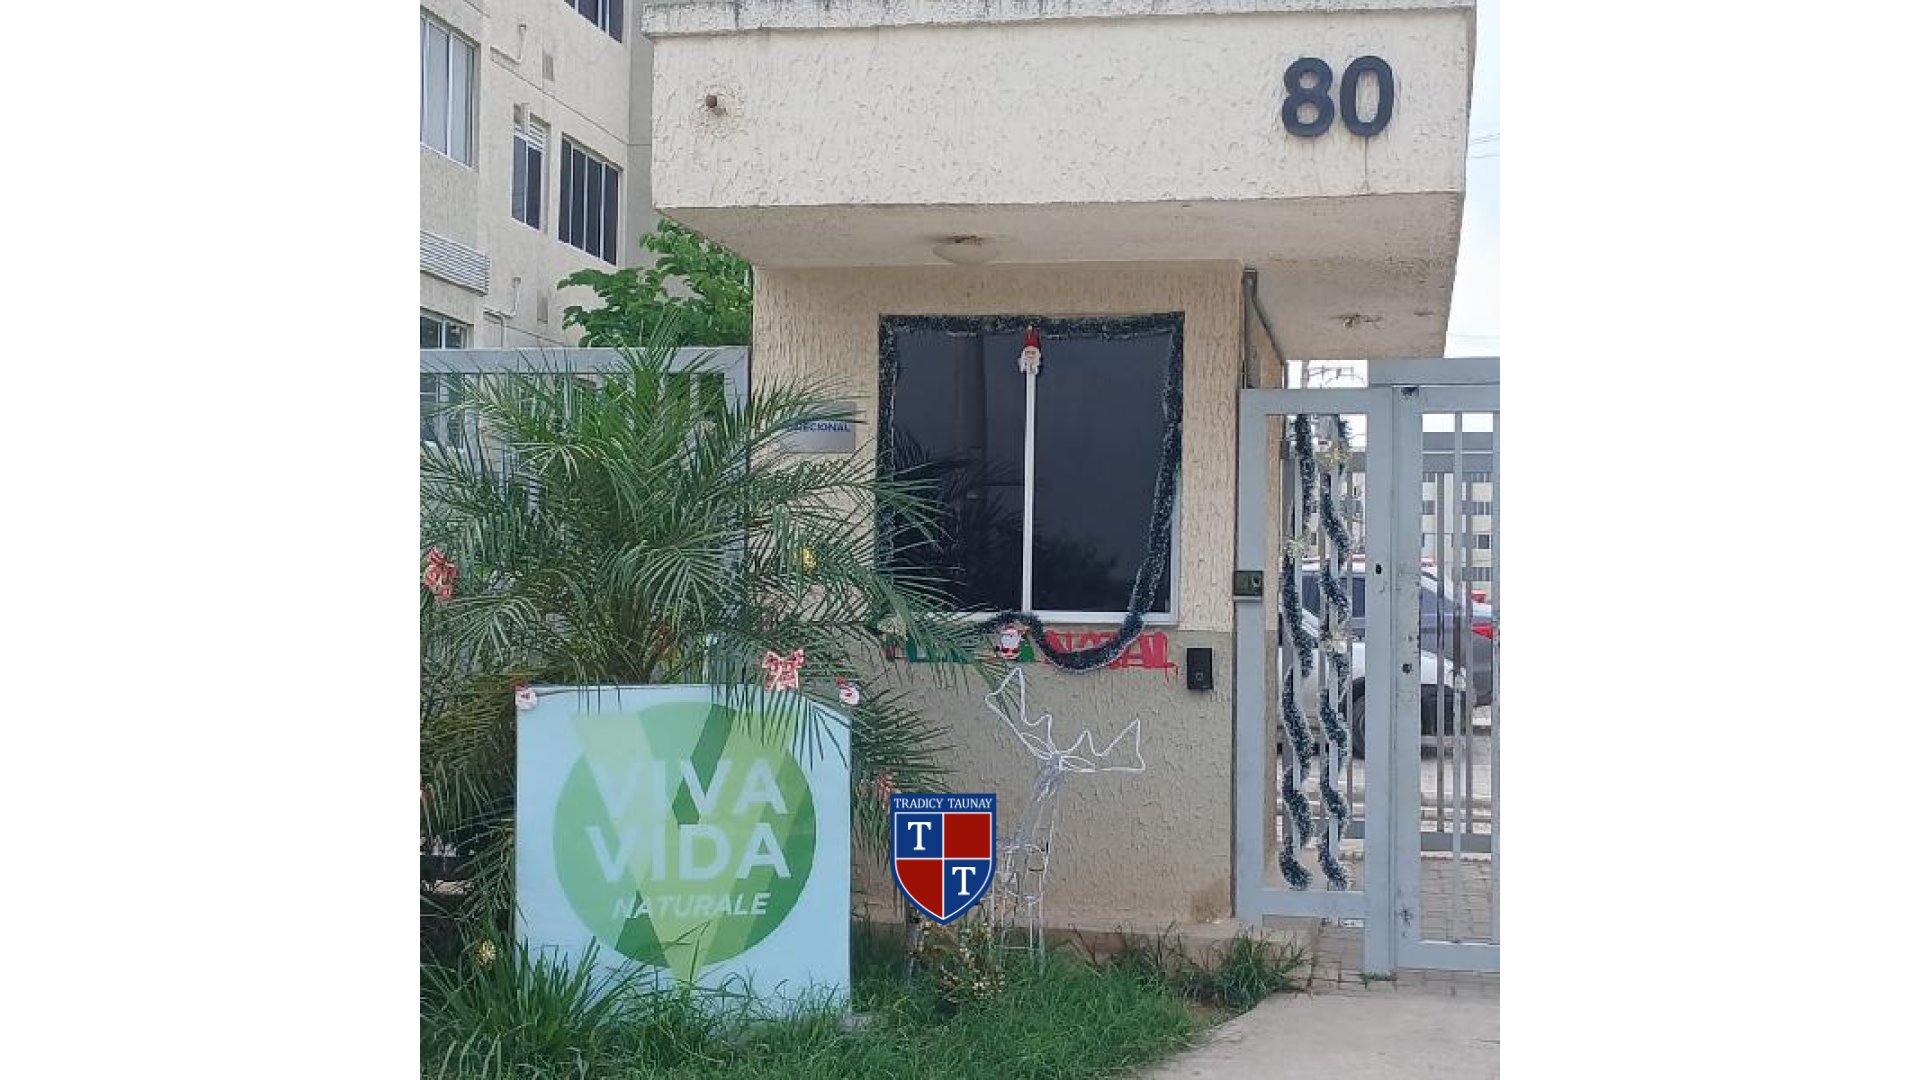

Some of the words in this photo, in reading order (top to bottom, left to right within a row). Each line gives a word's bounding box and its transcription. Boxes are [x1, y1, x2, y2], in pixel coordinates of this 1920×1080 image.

[1282, 56, 1394, 137] 80
[591, 759, 789, 821] VIVA
[584, 822, 792, 882] VIDA
[612, 892, 772, 919] NATURALE
